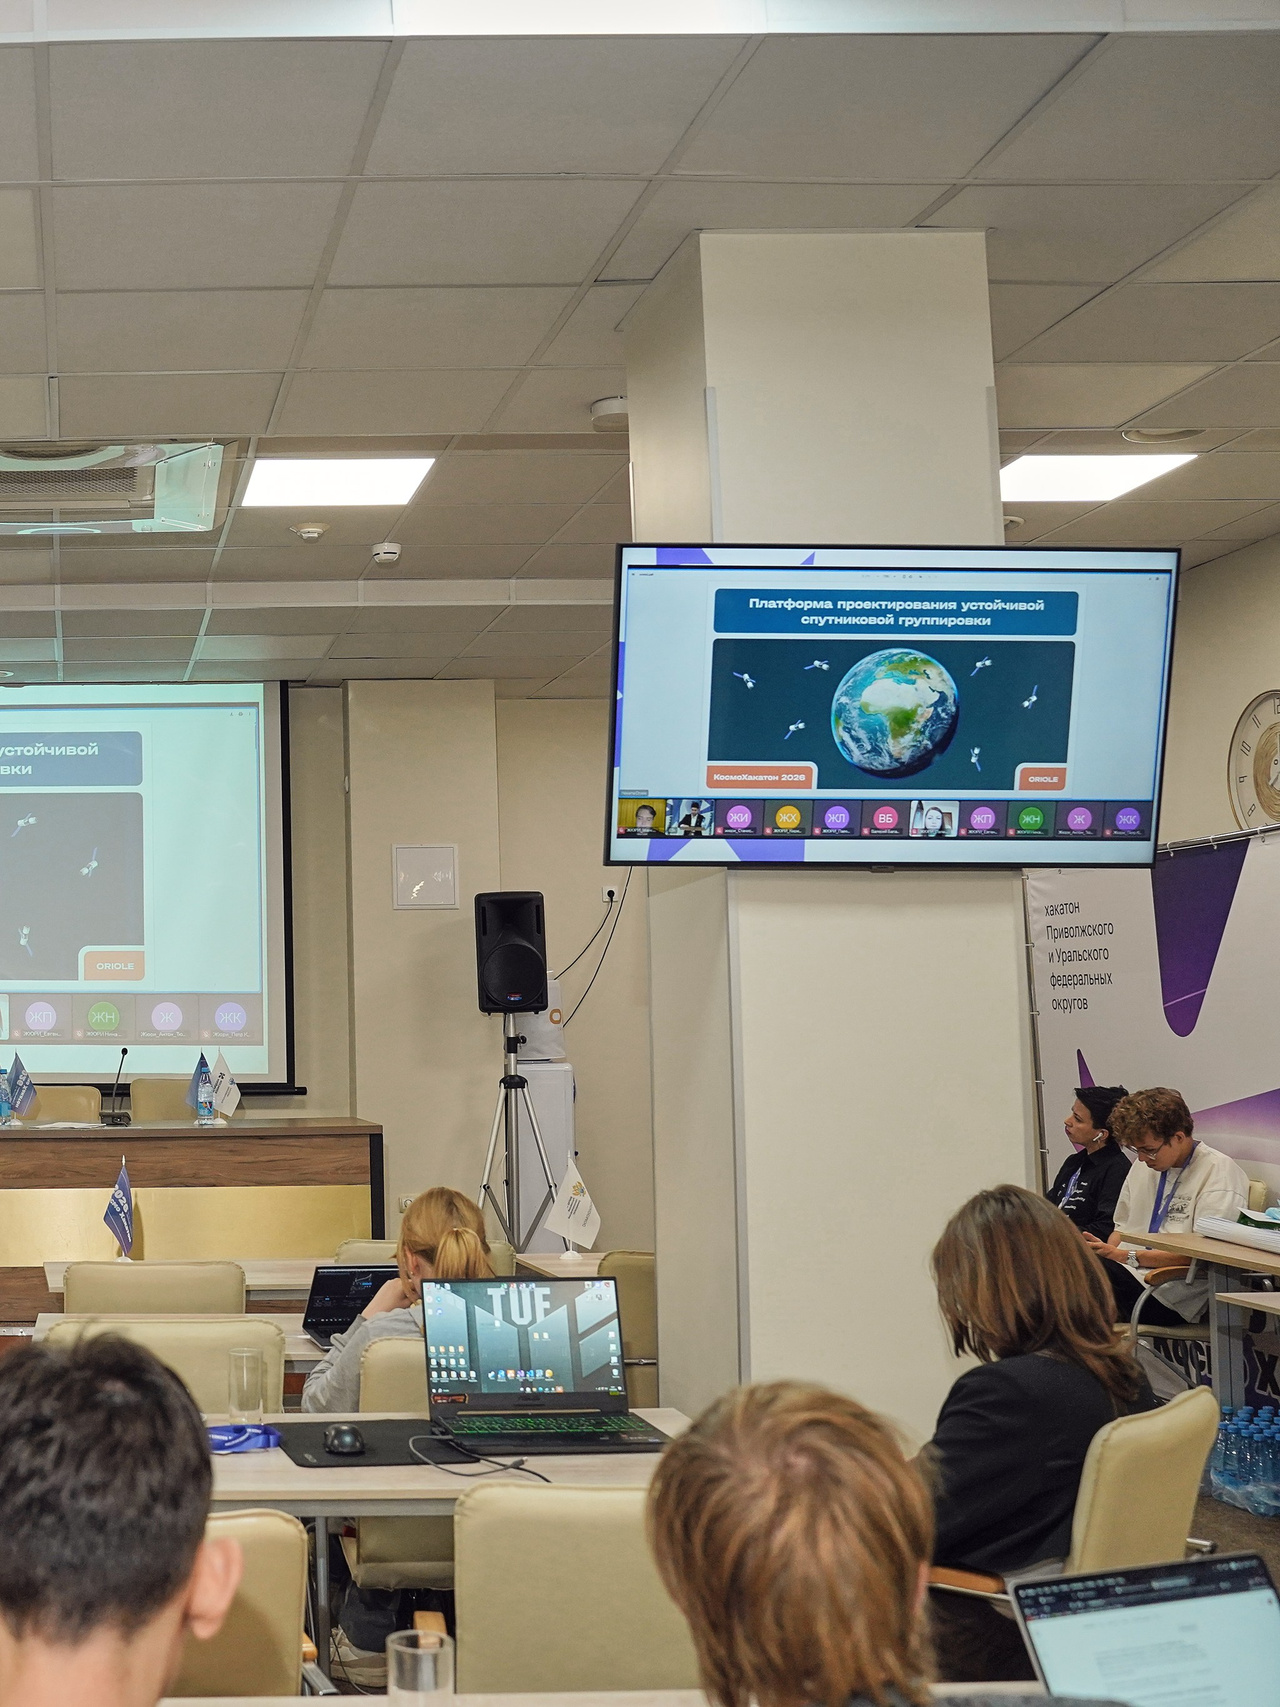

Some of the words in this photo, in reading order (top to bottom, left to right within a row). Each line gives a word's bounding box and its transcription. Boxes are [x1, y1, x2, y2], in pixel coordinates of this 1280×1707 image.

[749, 598, 833, 611] Платформа
[837, 600, 957, 612] проектирования
[961, 599, 1045, 612] устойчивой
[801, 614, 894, 626] спутниковой
[898, 616, 992, 627] группировки
[713, 773, 779, 782] КосмоХакатон
[781, 774, 806, 782] 2026
[1028, 776, 1059, 784] ORIOLE
[729, 813, 748, 822] ЖИ
[779, 813, 797, 822] ЖХ
[827, 813, 846, 823] ЖЛ
[878, 814, 893, 823] ВБ
[973, 814, 992, 824] ЖП
[1022, 815, 1041, 824] ЖН
[1118, 815, 1137, 824] ЖК
[1044, 901, 1081, 917] хакатон
[1046, 922, 1114, 943] Приволжского
[1048, 951, 1055, 963] и
[1055, 947, 1109, 966] Уральского
[96, 962, 135, 970] ORIOLE
[1050, 972, 1113, 990] федеральных
[1052, 996, 1089, 1014] округов
[29, 1011, 52, 1023] ЖП
[92, 1012, 115, 1022] ЖН
[160, 1012, 173, 1023] Ж
[220, 1012, 241, 1023] ЖК
[487, 1287, 551, 1325] TUF
